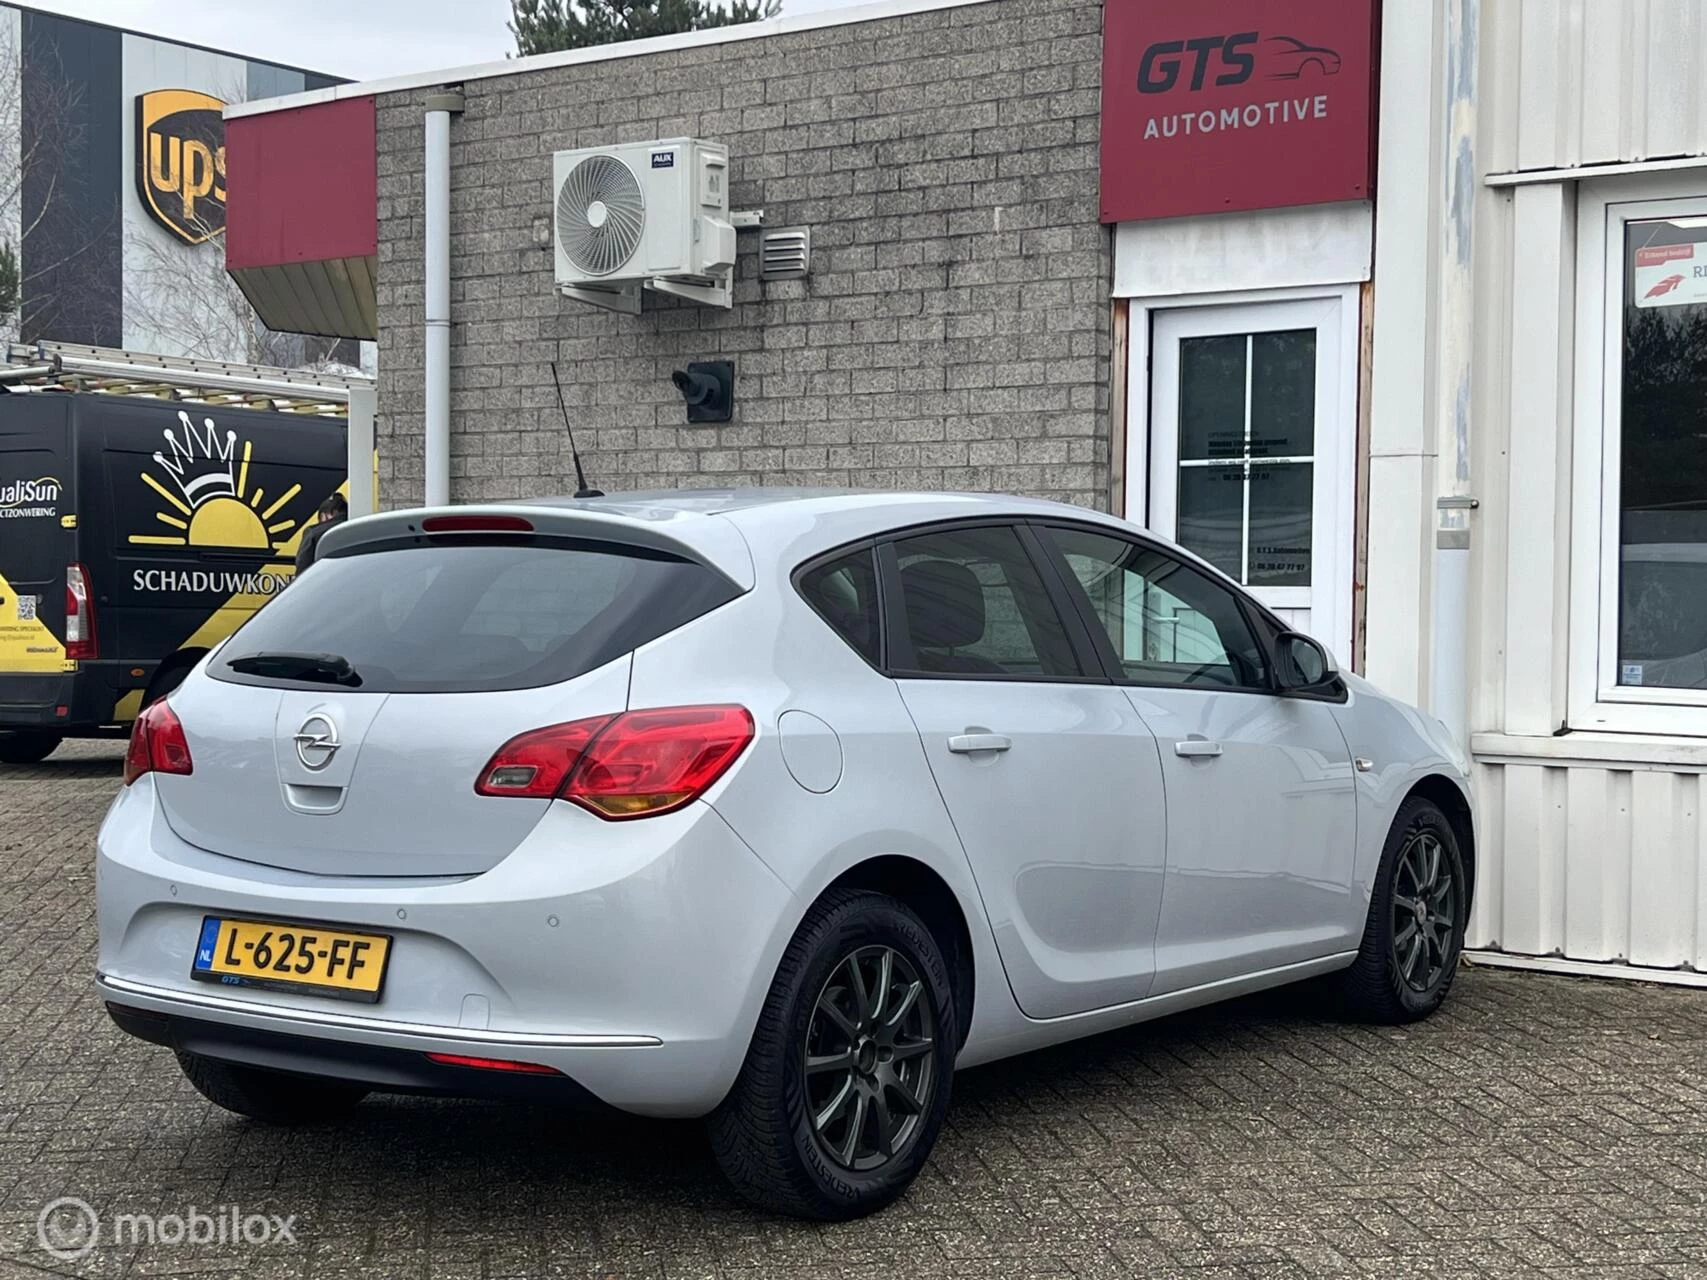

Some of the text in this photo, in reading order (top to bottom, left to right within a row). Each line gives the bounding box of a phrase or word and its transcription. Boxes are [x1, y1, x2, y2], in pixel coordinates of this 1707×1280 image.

[1137, 31, 1260, 94] GTS
[1144, 95, 1328, 140] AUTOMOTIVE
[653, 154, 671, 162] AUX
[133, 569, 296, 595] SCHADUWKON
[199, 949, 212, 962] NL
[224, 928, 371, 980] L-625-FF
[221, 975, 240, 985] GTS
